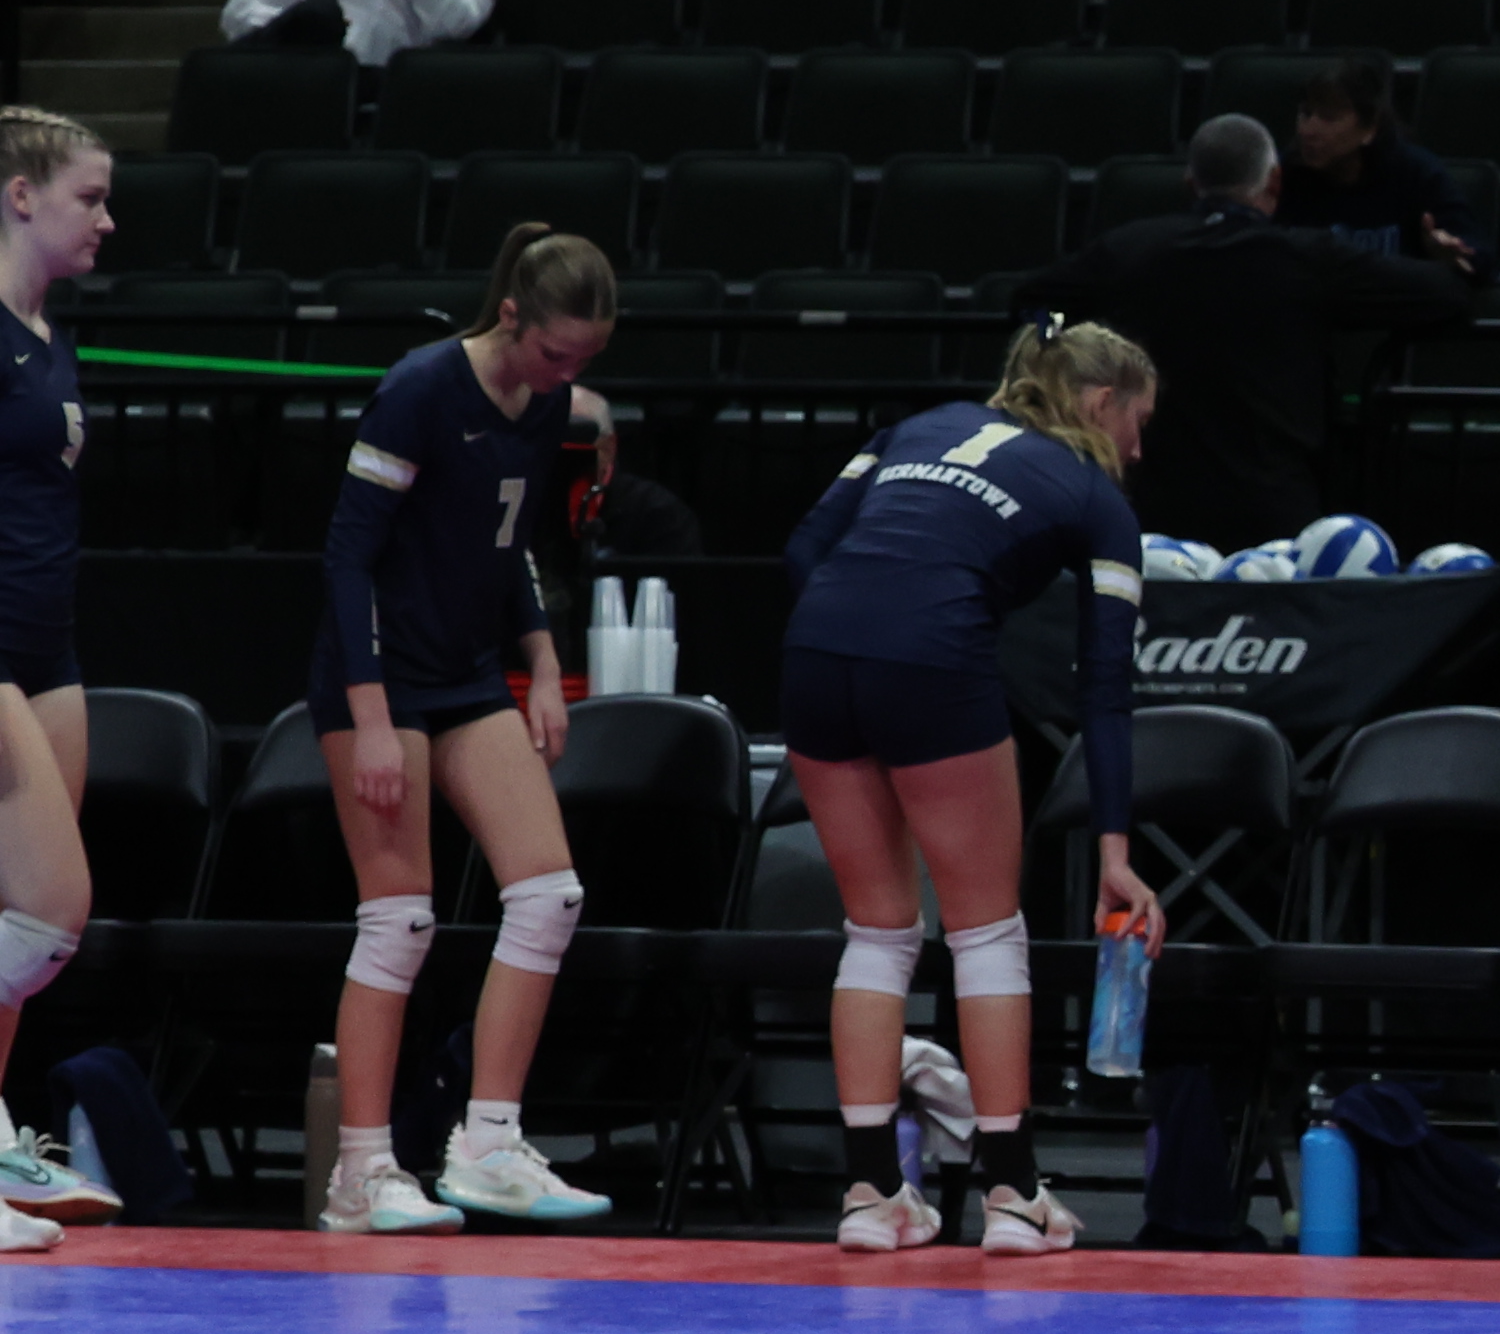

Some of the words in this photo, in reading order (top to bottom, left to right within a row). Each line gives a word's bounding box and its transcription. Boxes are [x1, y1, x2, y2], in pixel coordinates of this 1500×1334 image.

[940, 422, 1024, 469] 1
[495, 478, 527, 549] 7
[1133, 614, 1308, 674] aden
